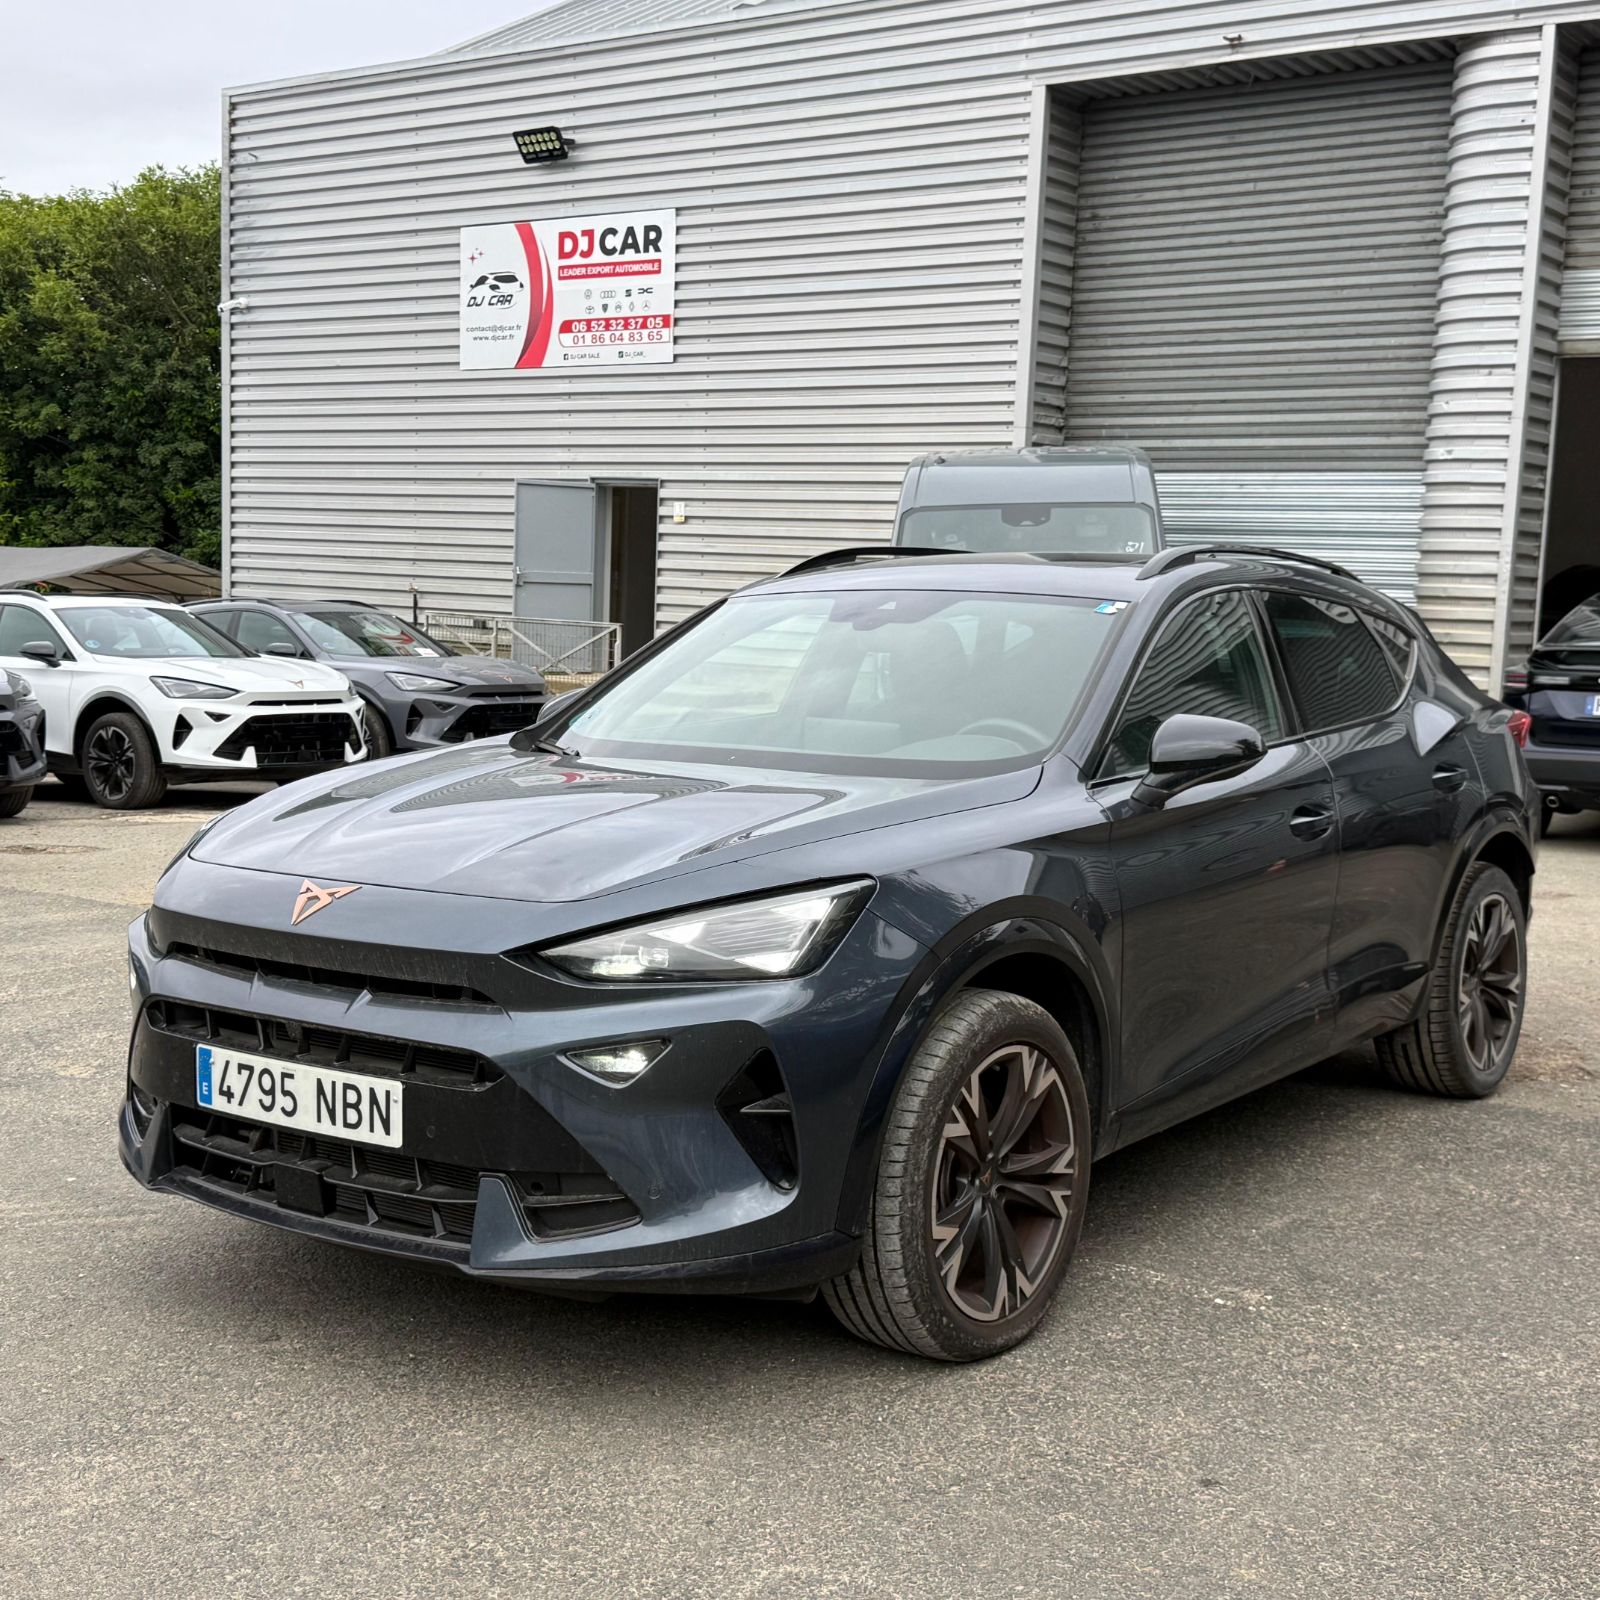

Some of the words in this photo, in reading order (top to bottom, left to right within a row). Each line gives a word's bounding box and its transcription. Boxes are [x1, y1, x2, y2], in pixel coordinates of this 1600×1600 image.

[558, 228, 595, 260] DJ
[599, 224, 663, 257] CAR
[560, 267, 586, 277] LEADER
[587, 265, 614, 275] EXPORT
[615, 262, 660, 273] AUTOMOBILE
[466, 295, 486, 308] DJ
[487, 293, 514, 306] CAR
[466, 324, 522, 333] contact@djcar.fr
[571, 321, 587, 333] 06
[590, 320, 606, 332] 52
[609, 319, 624, 331] 32
[627, 318, 643, 330] 37
[646, 317, 663, 329] 05
[473, 334, 515, 342] www.djcar.fr
[572, 334, 586, 345] 01
[590, 333, 605, 344] 86
[609, 332, 624, 343] 04
[628, 331, 643, 342] 83
[647, 330, 663, 341] 65
[202, 1082, 209, 1095] E
[218, 1059, 298, 1118] 4795
[316, 1077, 391, 1137] NBN
